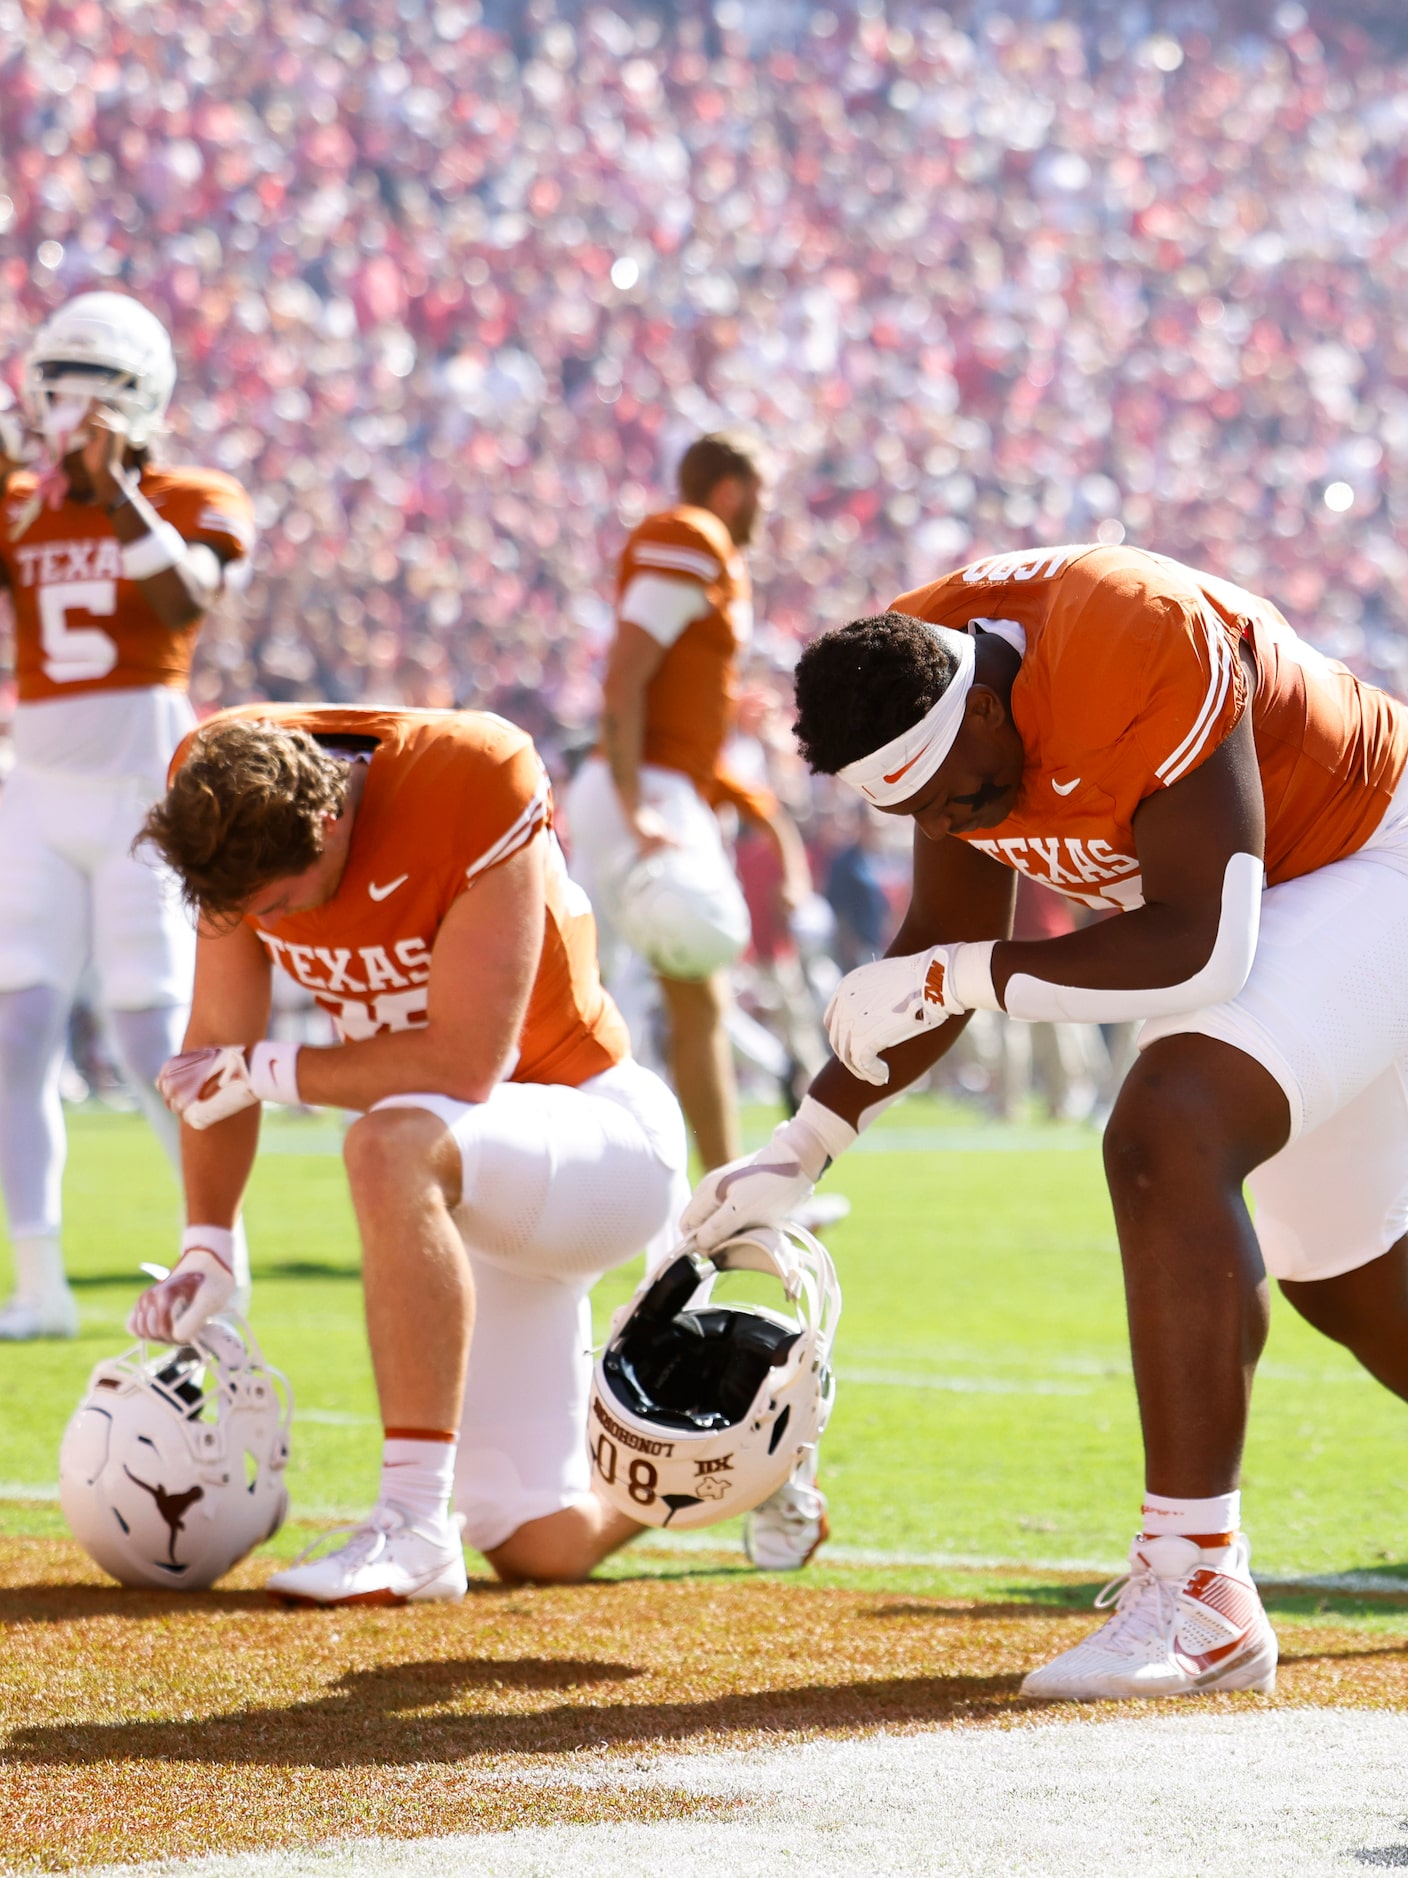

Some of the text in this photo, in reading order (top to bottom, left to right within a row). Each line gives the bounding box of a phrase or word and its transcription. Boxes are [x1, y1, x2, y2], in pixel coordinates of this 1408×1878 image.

[15, 539, 120, 587] TEXA
[39, 579, 118, 682] 5
[968, 837, 1140, 884] TEXAS
[256, 928, 432, 992] TEXAS
[596, 1433, 657, 1506] 80
[694, 1452, 735, 1478] XII
